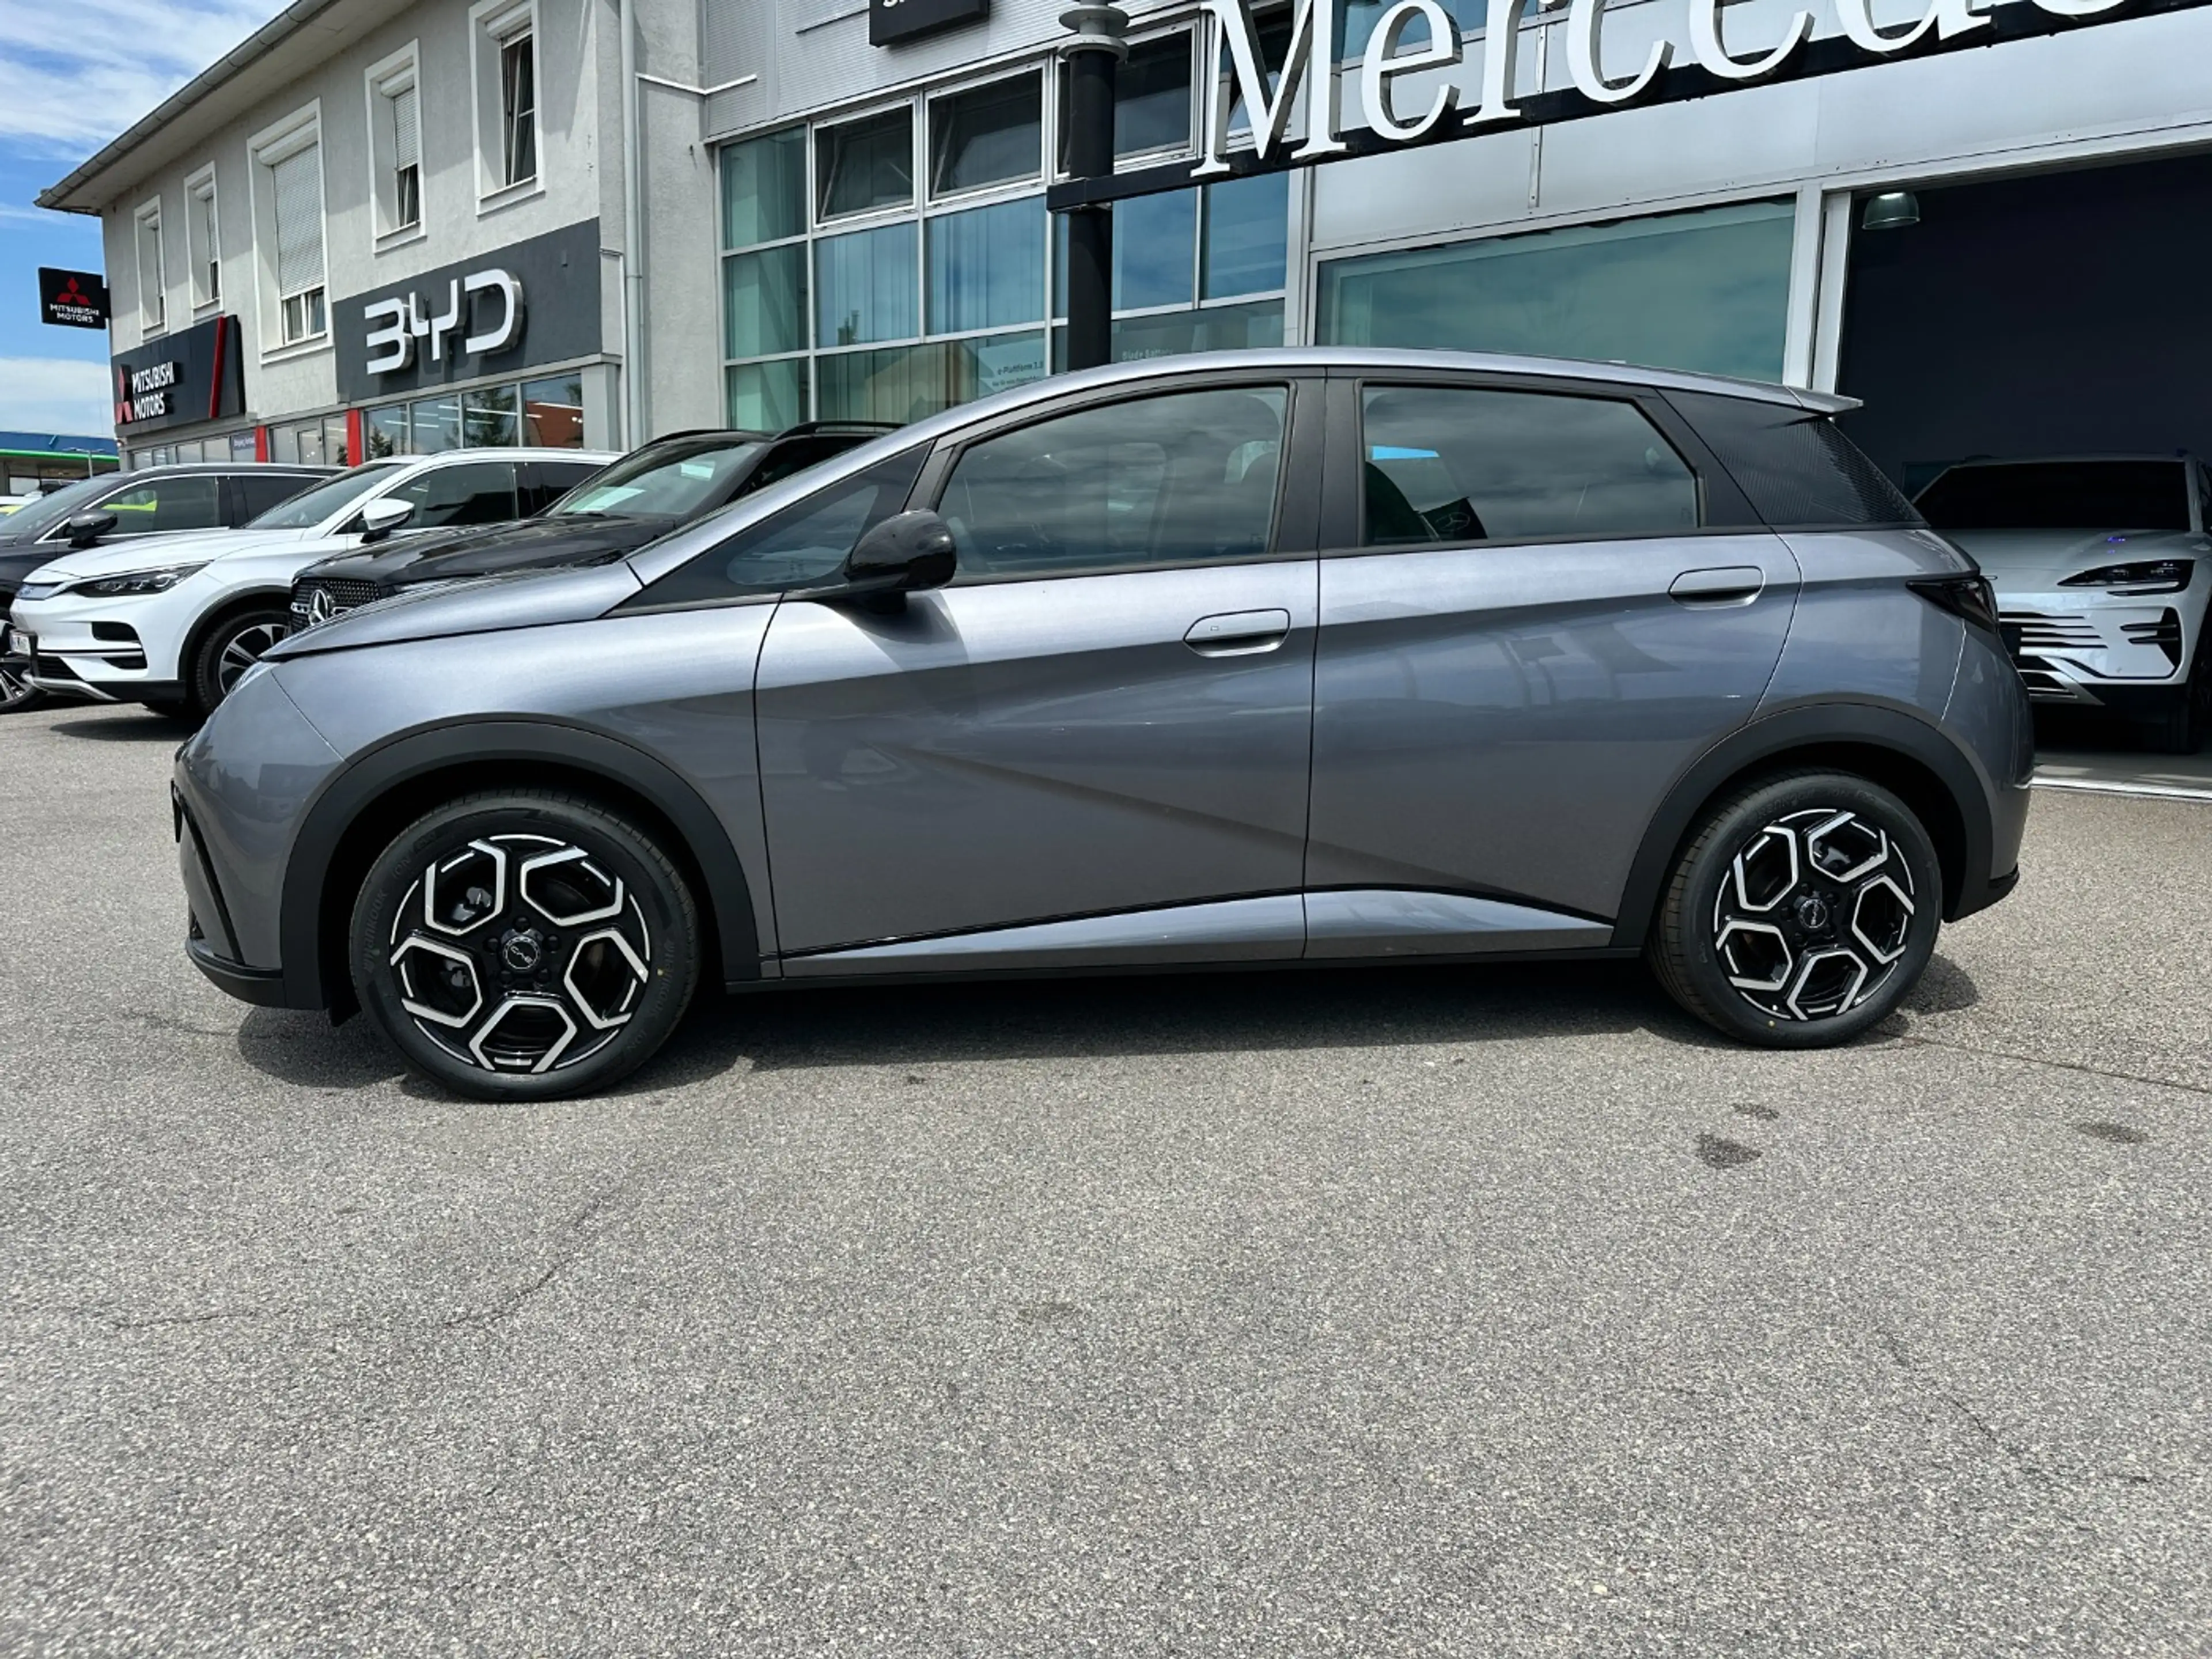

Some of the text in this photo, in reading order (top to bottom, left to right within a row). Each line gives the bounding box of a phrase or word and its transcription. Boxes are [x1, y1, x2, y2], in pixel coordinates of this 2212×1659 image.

[50, 303, 100, 316] MITSUBISHI
[56, 312, 94, 323] MOTORS
[365, 268, 514, 375] BYD
[131, 361, 175, 394] MITSUBISHI
[134, 392, 165, 421] MOTORS
